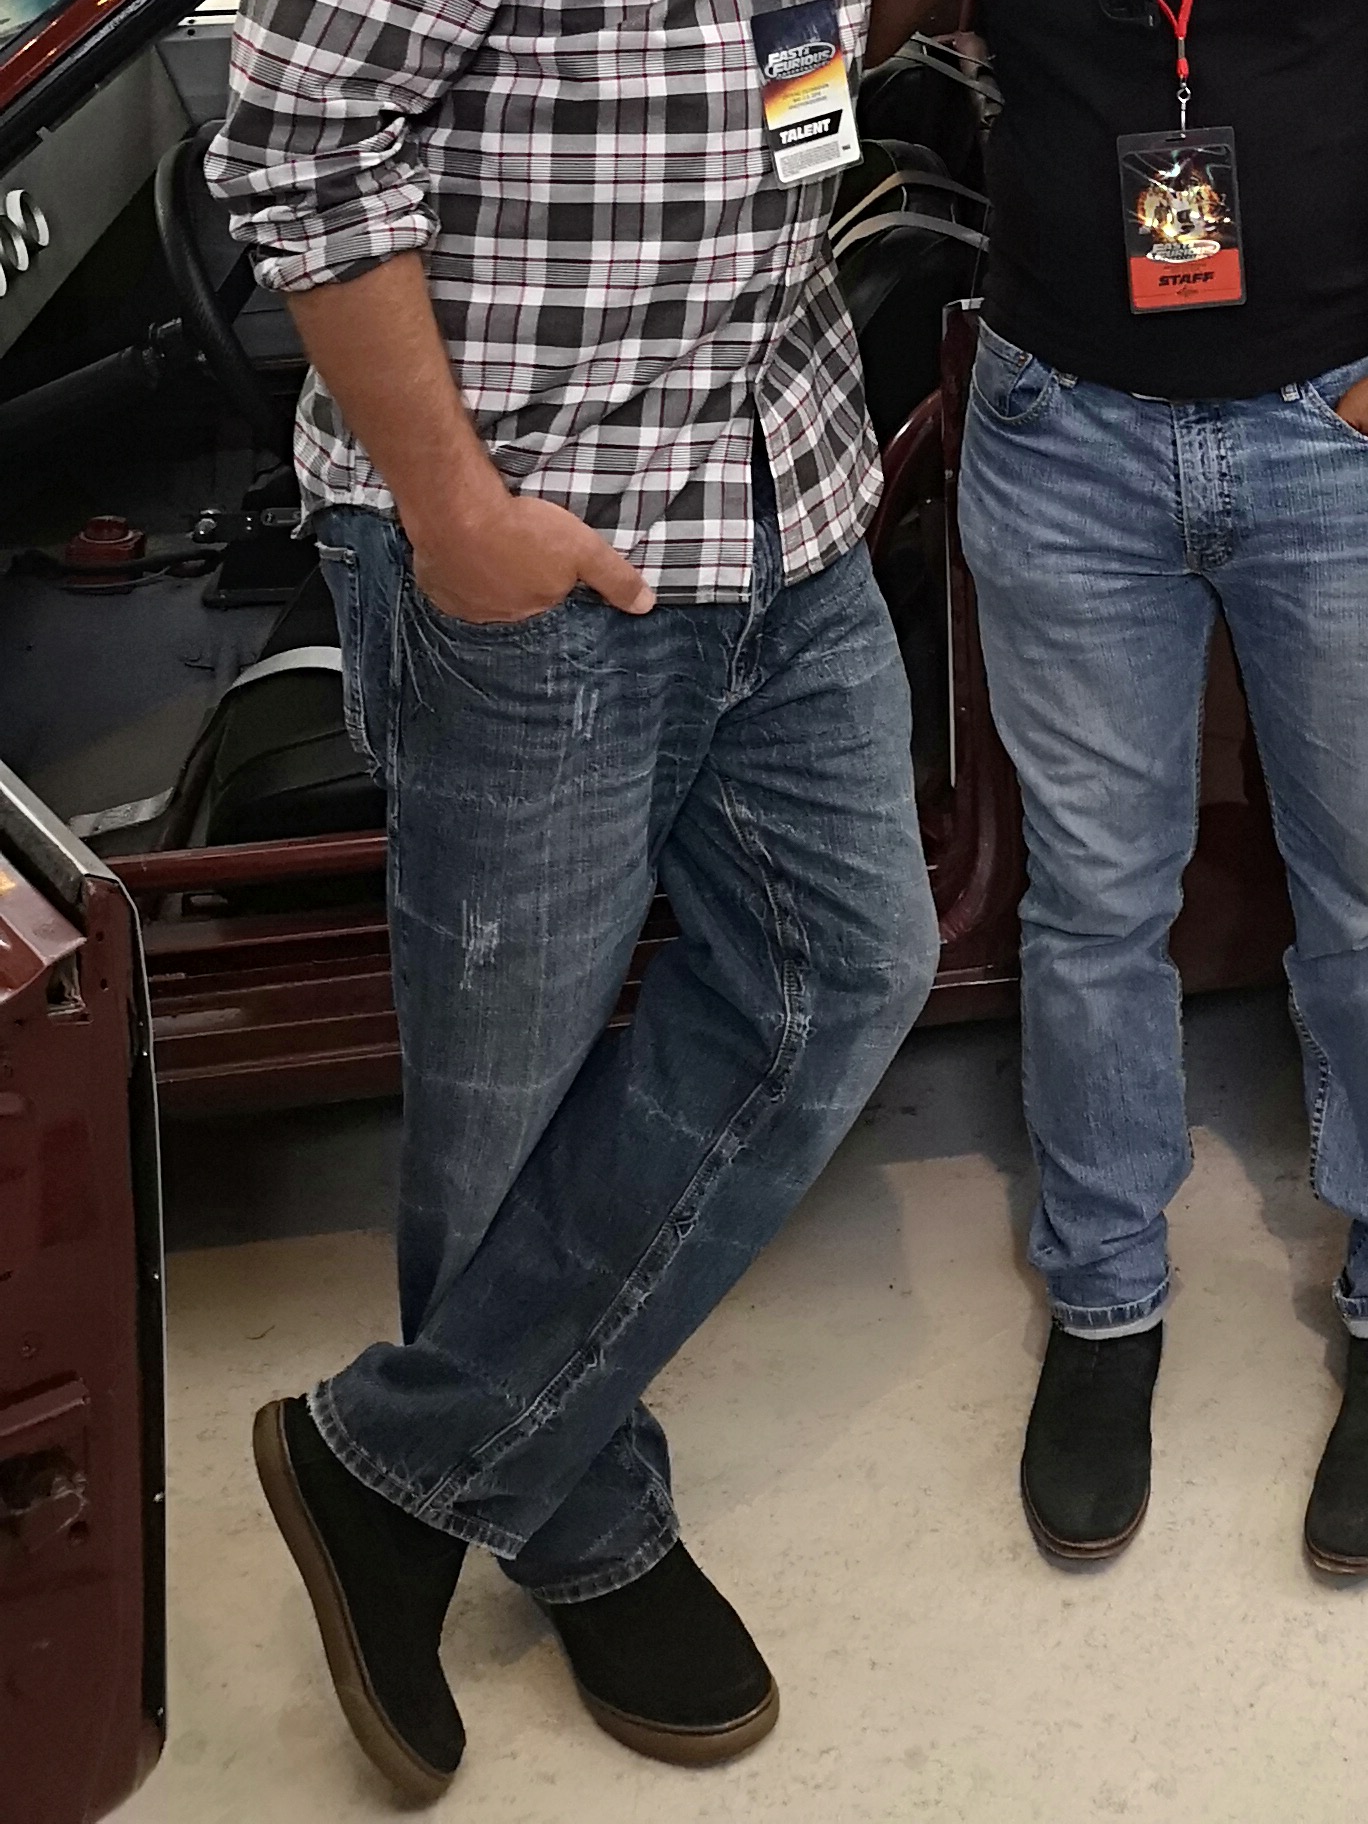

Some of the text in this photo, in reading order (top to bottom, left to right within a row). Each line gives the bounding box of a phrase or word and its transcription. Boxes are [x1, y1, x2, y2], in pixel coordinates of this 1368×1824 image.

[772, 50, 831, 77] FURIOUS
[779, 118, 831, 144] TALENT
[1158, 271, 1215, 287] STAFF
